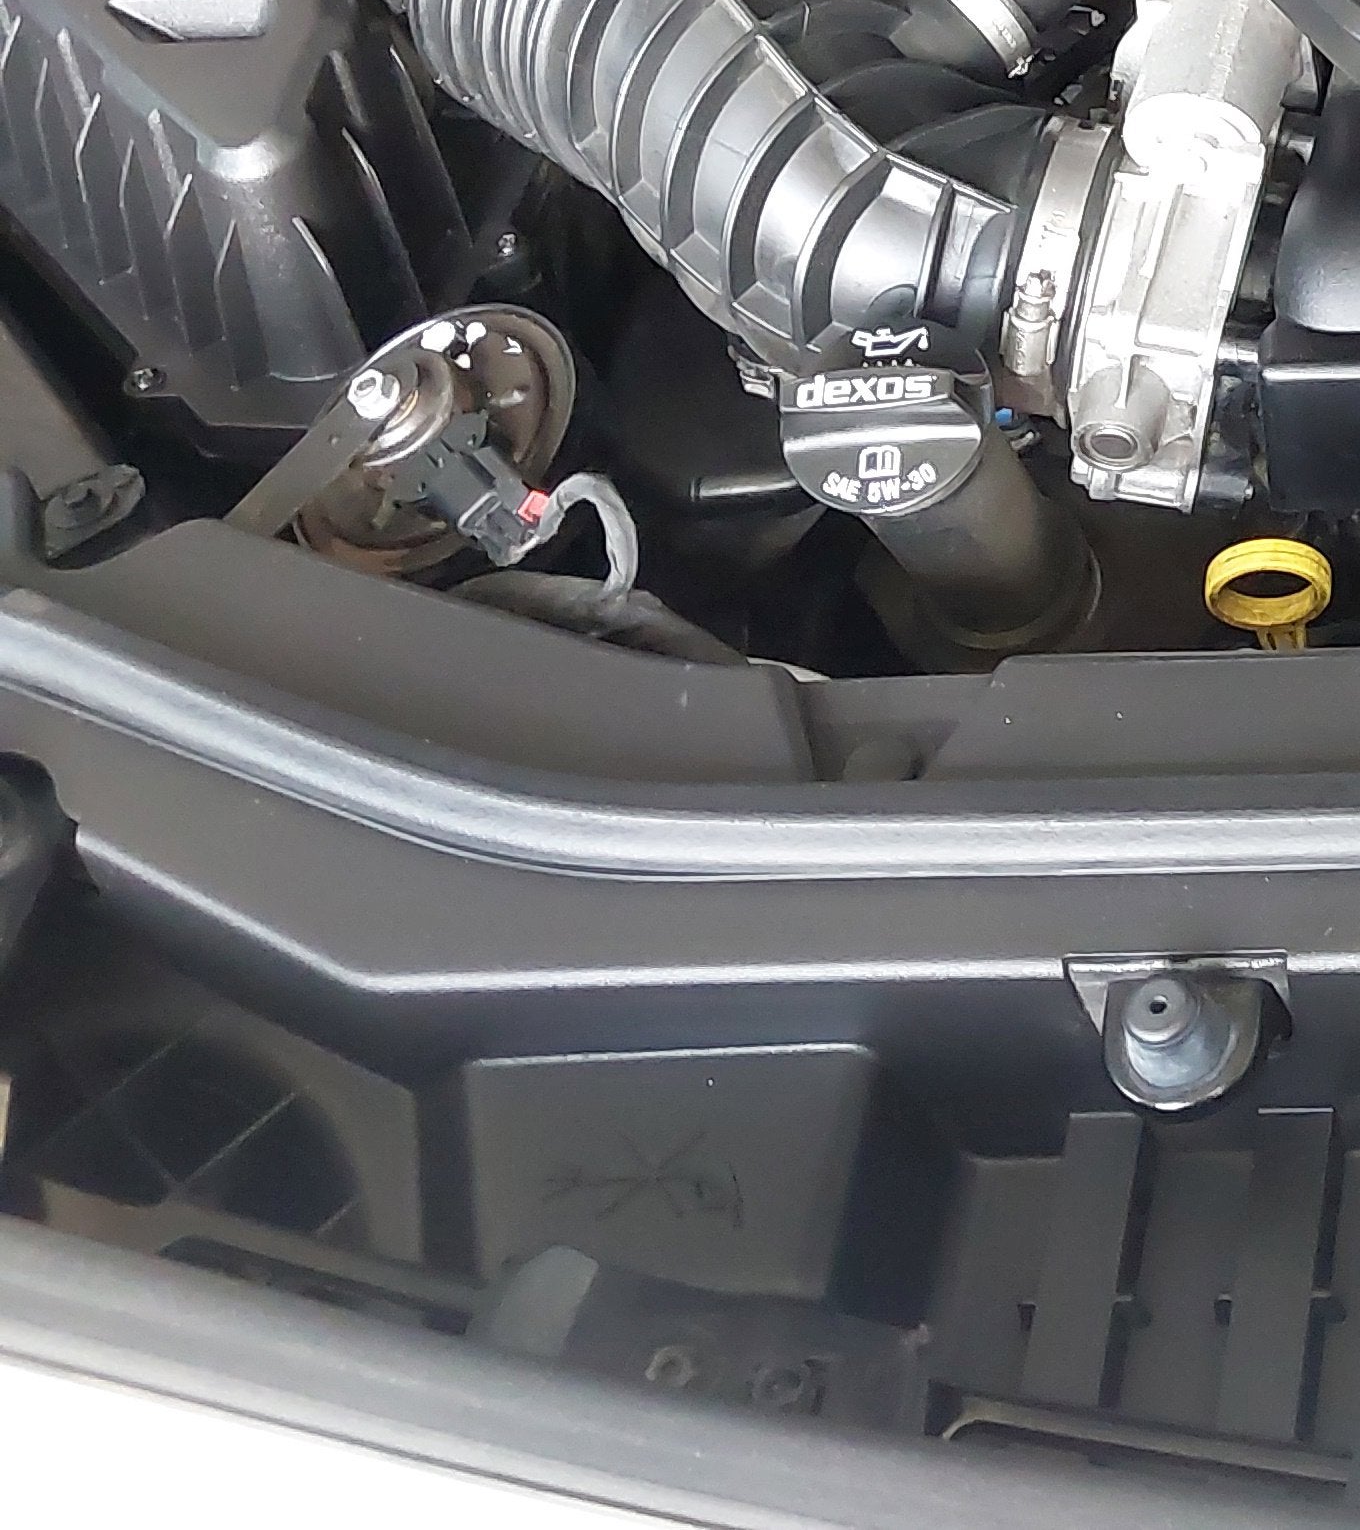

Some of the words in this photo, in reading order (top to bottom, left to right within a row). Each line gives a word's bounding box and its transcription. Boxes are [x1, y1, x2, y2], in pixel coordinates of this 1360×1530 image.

[796, 374, 936, 409] dexos
[822, 471, 862, 503] SAE
[867, 462, 938, 503] 5W-30
